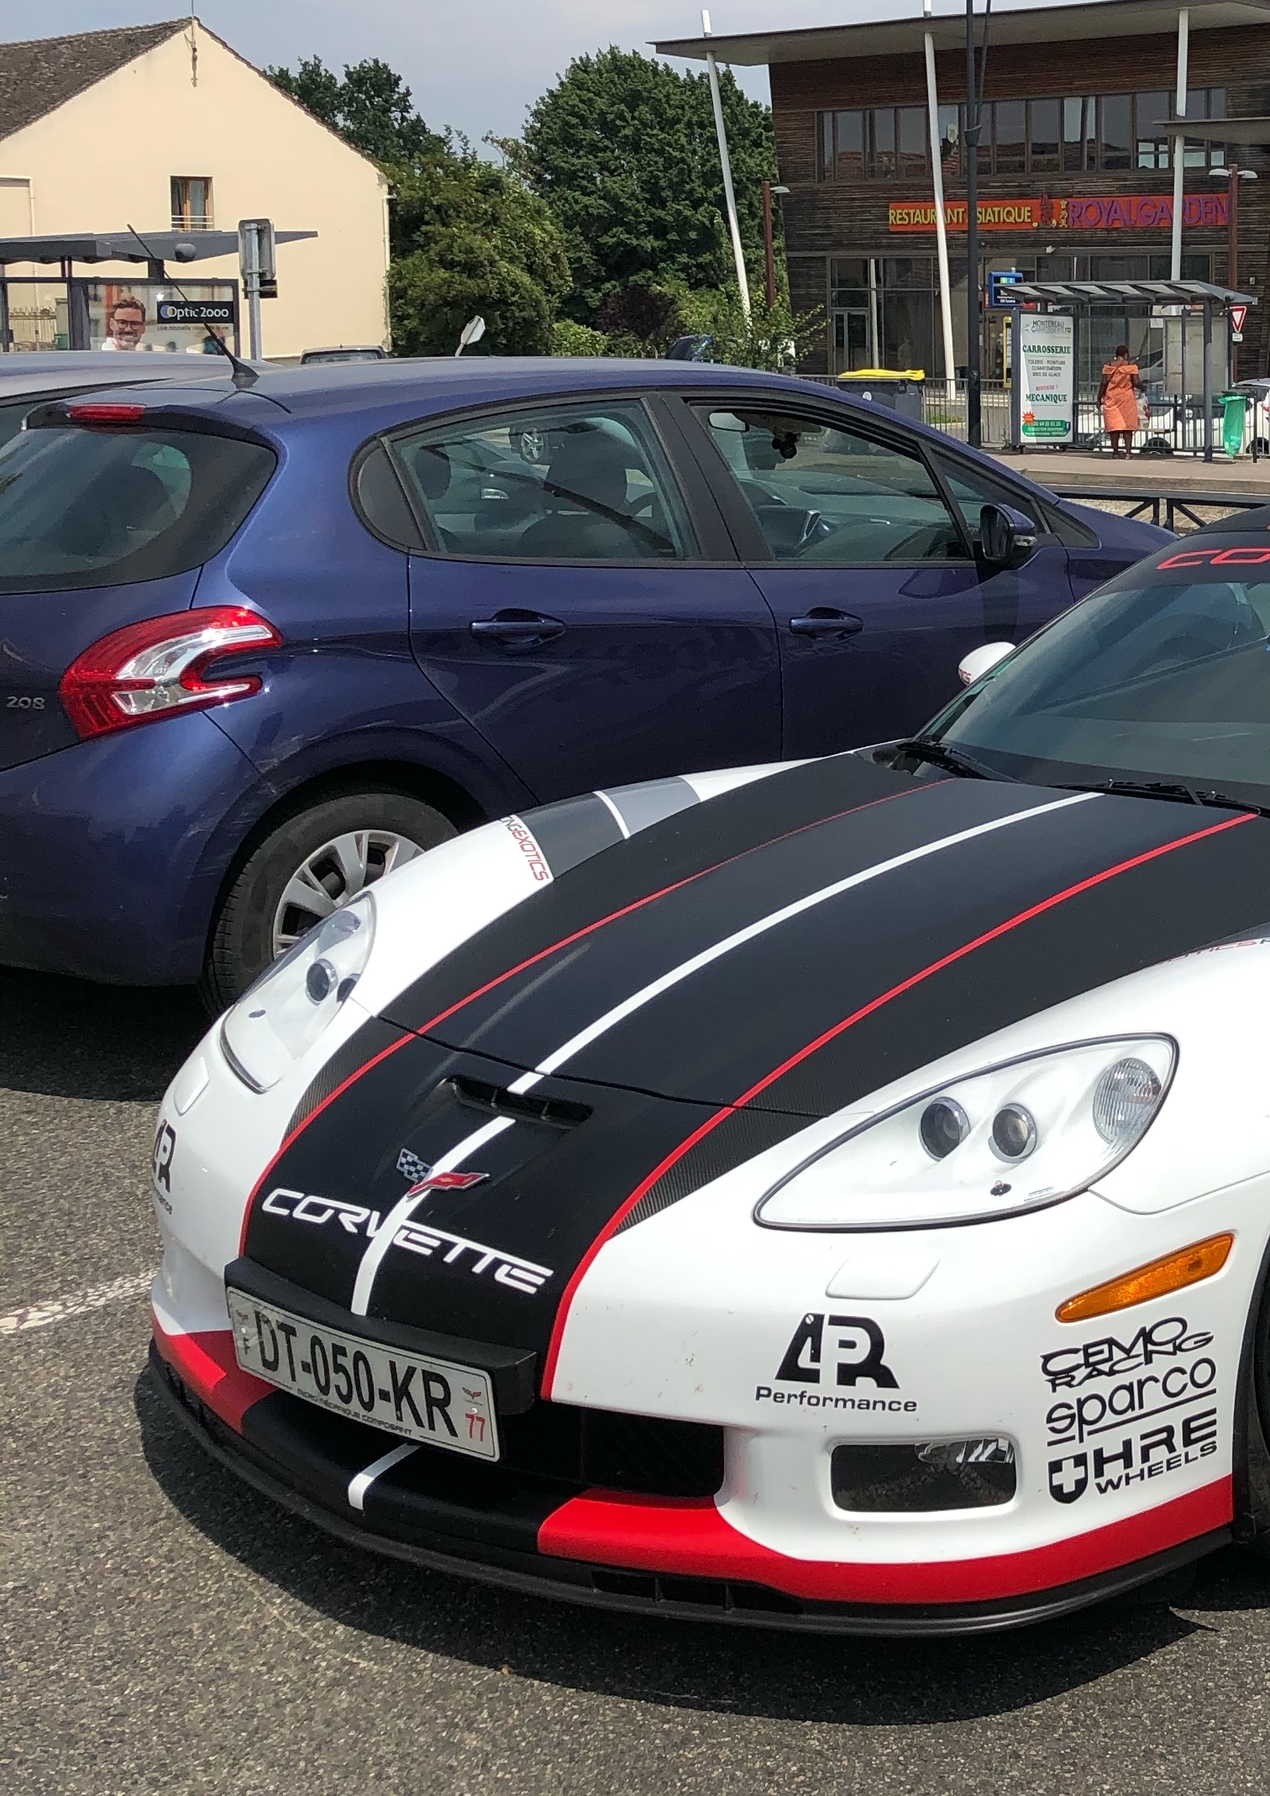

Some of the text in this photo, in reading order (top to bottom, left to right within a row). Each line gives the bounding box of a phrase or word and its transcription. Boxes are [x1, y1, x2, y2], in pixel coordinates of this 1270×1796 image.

[889, 206, 1032, 225] RESTAURNT SIATIQUE
[1069, 199, 1137, 227] ROYAL
[1137, 197, 1229, 225] GADEN
[166, 305, 229, 321] Optic 2000
[1022, 344, 1071, 354] CARROSSERIE
[1025, 393, 1068, 403] MECANIQUE
[7, 695, 46, 710] 208
[262, 1188, 555, 1295] CORVETTE
[254, 1309, 459, 1438] DT-050-KR
[464, 1412, 486, 1442] 77
[755, 1385, 918, 1413] Performance
[1046, 1357, 1217, 1445] sparco
[1093, 1407, 1218, 1480] HRE
[1094, 1440, 1218, 1495] WHEELS
